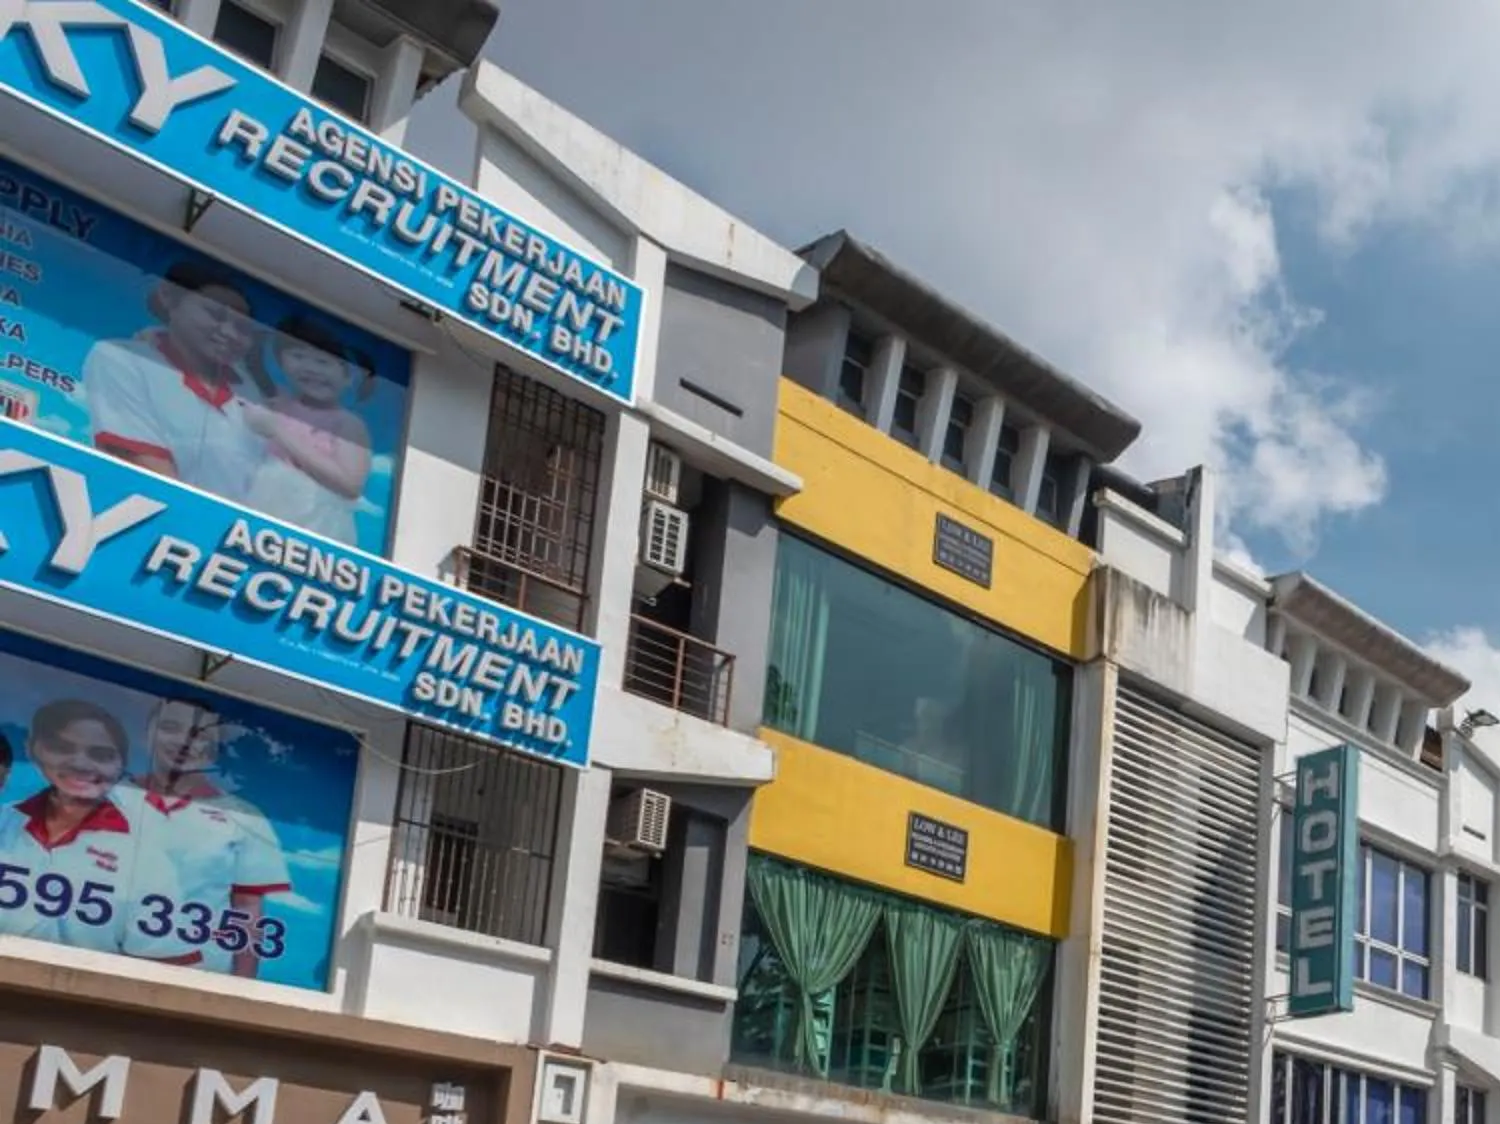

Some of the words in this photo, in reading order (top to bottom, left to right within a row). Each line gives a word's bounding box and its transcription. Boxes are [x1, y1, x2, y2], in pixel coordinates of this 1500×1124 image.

[218, 109, 626, 343] RECRUITMENT
[290, 107, 428, 198] AGENSI
[435, 185, 627, 311] PEKERJAAN
[467, 281, 541, 340] SDN.
[550, 328, 620, 379] BHD.
[145, 534, 580, 712] RECRUITMENT
[225, 519, 370, 596] AGENSI
[380, 575, 585, 674] PEKERJAAN
[412, 671, 491, 721] SDN.
[502, 702, 573, 747] BHD.
[0, 862, 115, 926] 595
[137, 893, 286, 959] 3353
[1295, 761, 1339, 997] HOTEL
